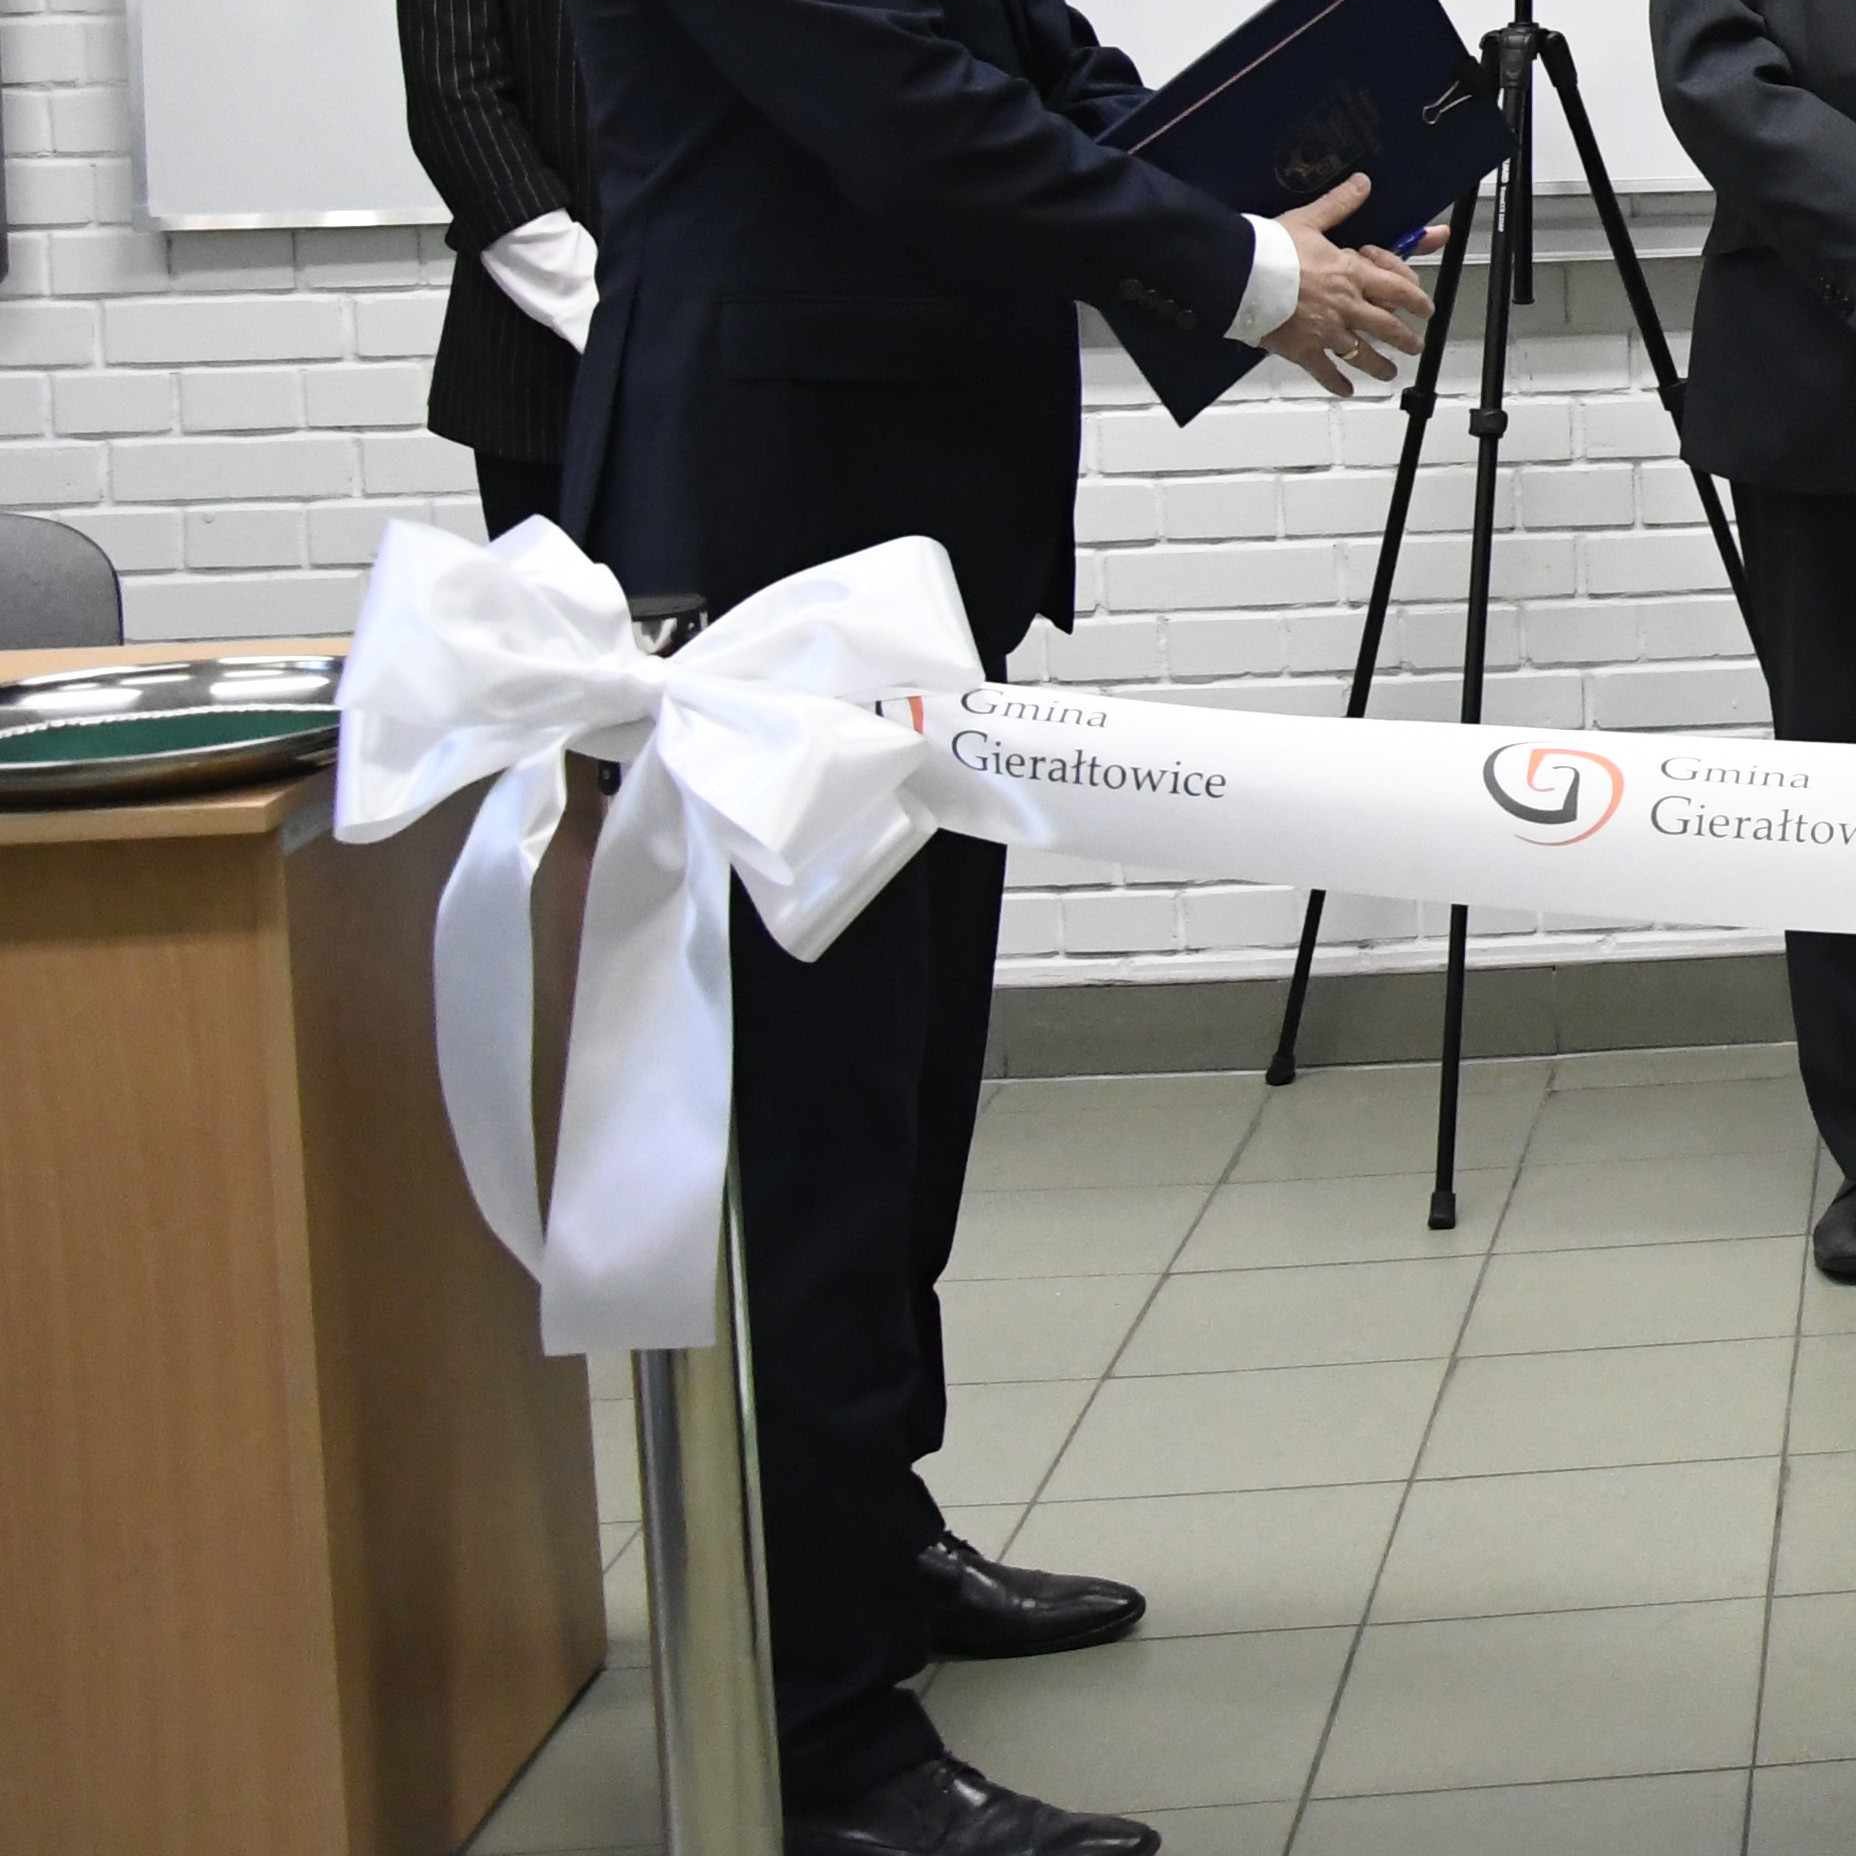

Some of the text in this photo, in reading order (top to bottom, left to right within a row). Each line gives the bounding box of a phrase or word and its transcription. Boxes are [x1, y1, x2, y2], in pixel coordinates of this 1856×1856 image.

[960, 687, 1107, 728] Gmina
[952, 730, 1226, 798] Gierałtowice
[1660, 756, 1810, 789] Gmina
